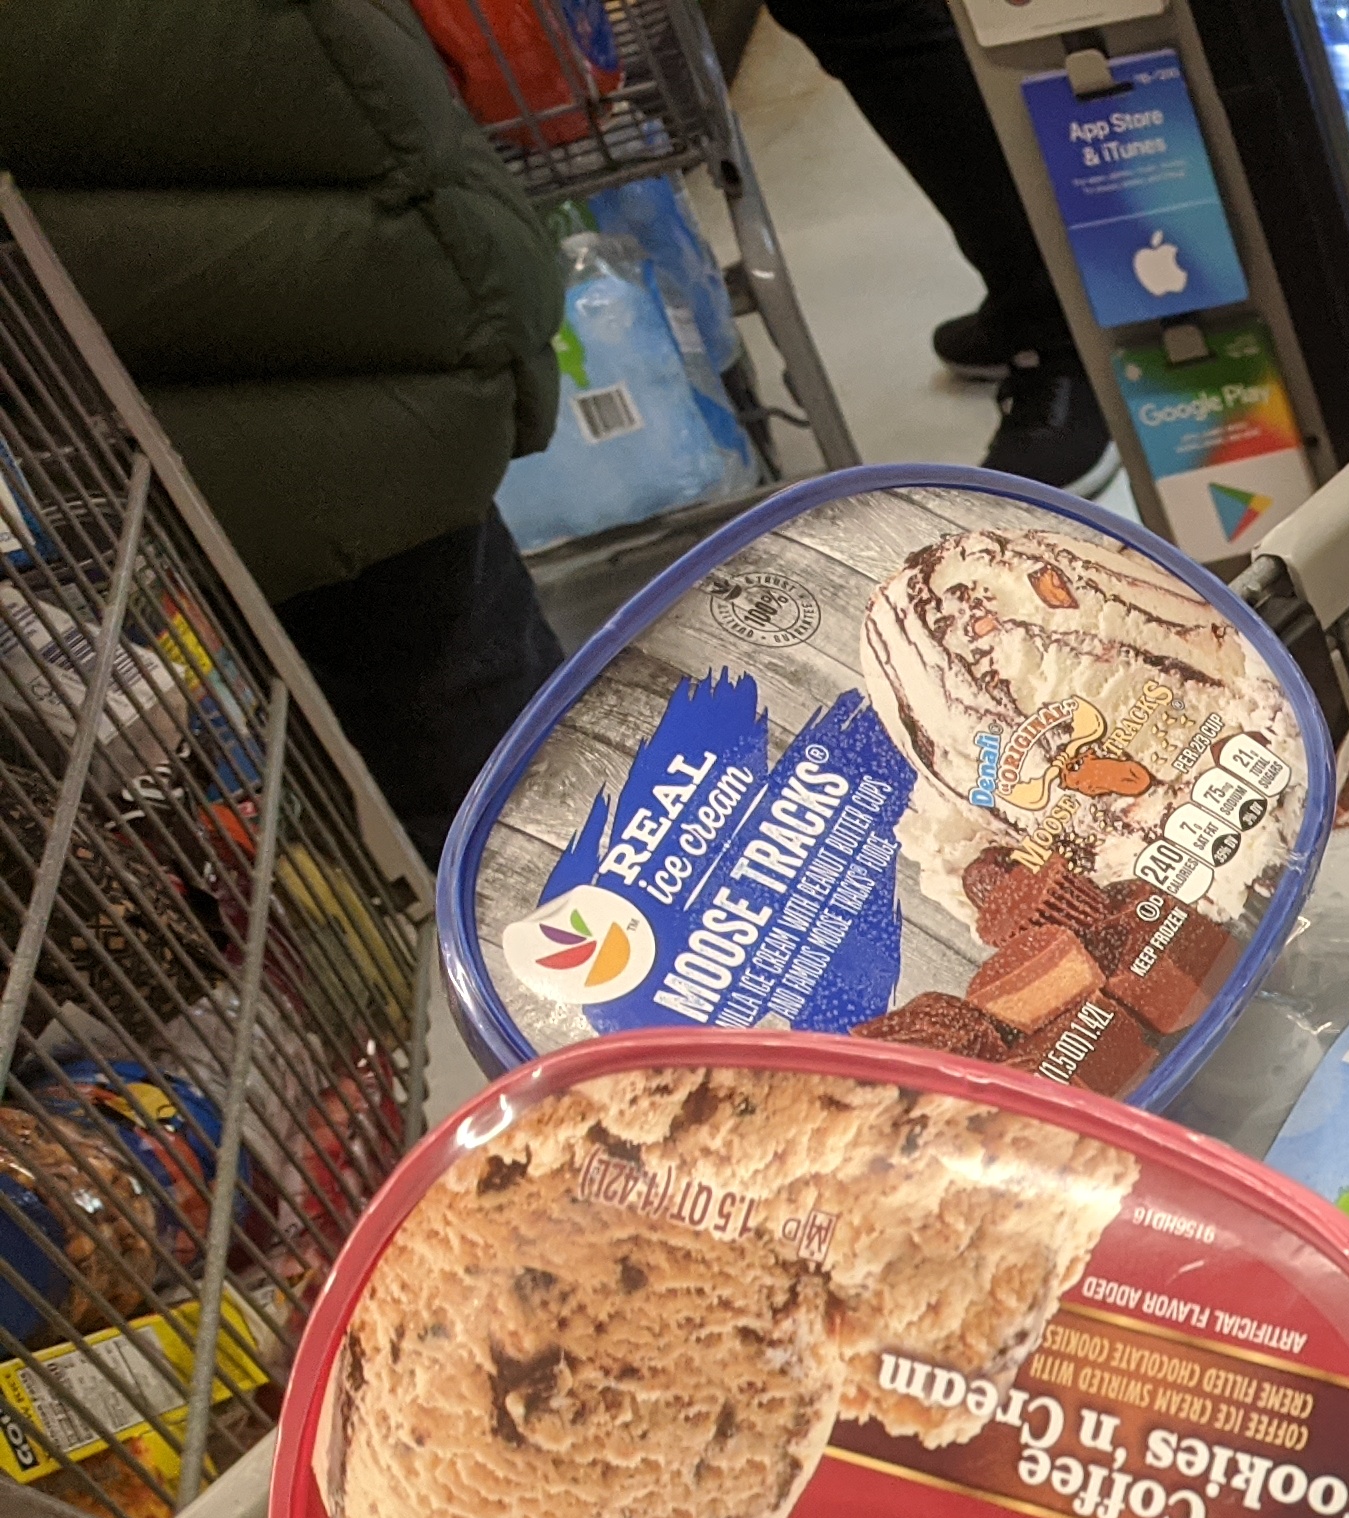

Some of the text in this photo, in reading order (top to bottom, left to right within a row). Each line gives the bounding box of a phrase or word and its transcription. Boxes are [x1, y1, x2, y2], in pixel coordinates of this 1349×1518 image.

[1067, 104, 1164, 144] App Store
[1081, 133, 1166, 166] & iTunes
[1137, 375, 1272, 435] Google Play
[744, 590, 788, 627] 100%
[1103, 681, 1175, 757] TRACKS
[1172, 711, 1226, 775] PER 2/3 CUP
[1248, 754, 1270, 779] TOTAL
[1258, 759, 1283, 789] SUGARS
[598, 751, 717, 885] REAL
[1219, 783, 1247, 816] SODIUM
[638, 765, 754, 906] ice cream
[856, 830, 897, 873] FUDGE
[1193, 821, 1220, 851] SAT FAT
[739, 772, 893, 999] ICE CREAM WITH PEANUT BUTTER CUPS
[1139, 840, 1184, 888] 240
[1166, 855, 1199, 895] CALORIES
[653, 888, 772, 1023] MOOSE
[808, 907, 852, 954] MOOSE
[1129, 905, 1188, 978] KEEP FROZEN
[783, 942, 830, 995] FAMOUS
[767, 984, 806, 1020] AND
[1071, 1002, 1114, 1040] 1.42L
[575, 1144, 758, 1239] 1.5 QT (1.42L)
[1130, 1206, 1216, 1243] 9156HD16
[1080, 1273, 1307, 1354] ARTIFICIAL FLAVOR ADDED
[1042, 1323, 1314, 1419] CREME FILLED CHOCOLATE COOKIES
[880, 1352, 1073, 1463] Cream
[1029, 1351, 1310, 1450] COFFEE ICE CREAM SWIRLED WITH
